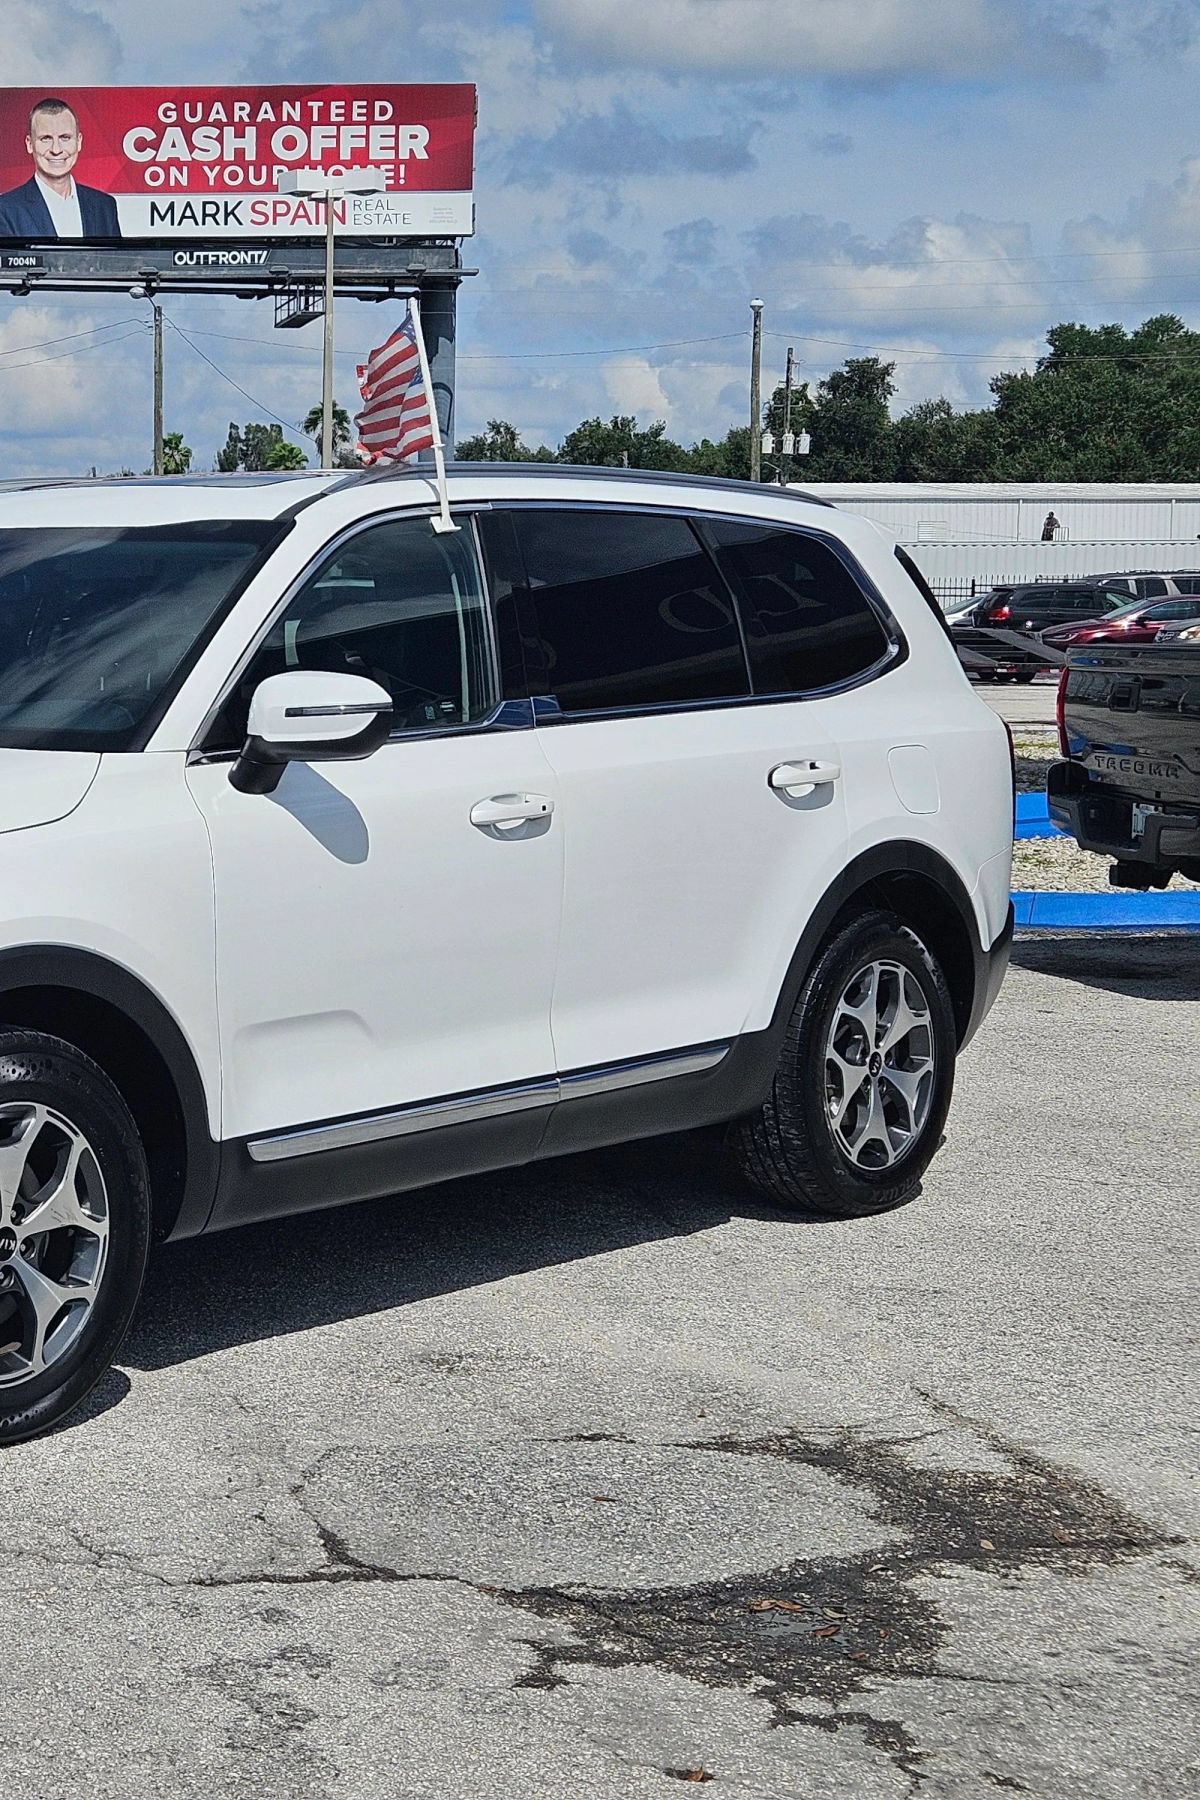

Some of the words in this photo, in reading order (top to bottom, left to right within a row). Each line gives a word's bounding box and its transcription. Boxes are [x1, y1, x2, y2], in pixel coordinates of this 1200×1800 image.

[157, 100, 394, 123] GUARANTEED
[122, 126, 257, 162] CASH
[271, 124, 430, 161] OFFER
[144, 166, 188, 186] ON
[150, 200, 244, 226] MARK
[250, 199, 347, 226] SPAIN
[353, 199, 395, 211] REAL
[353, 213, 412, 225] ESTATE
[7, 255, 36, 267] 7004N
[1094, 755, 1180, 779] TACOMA
